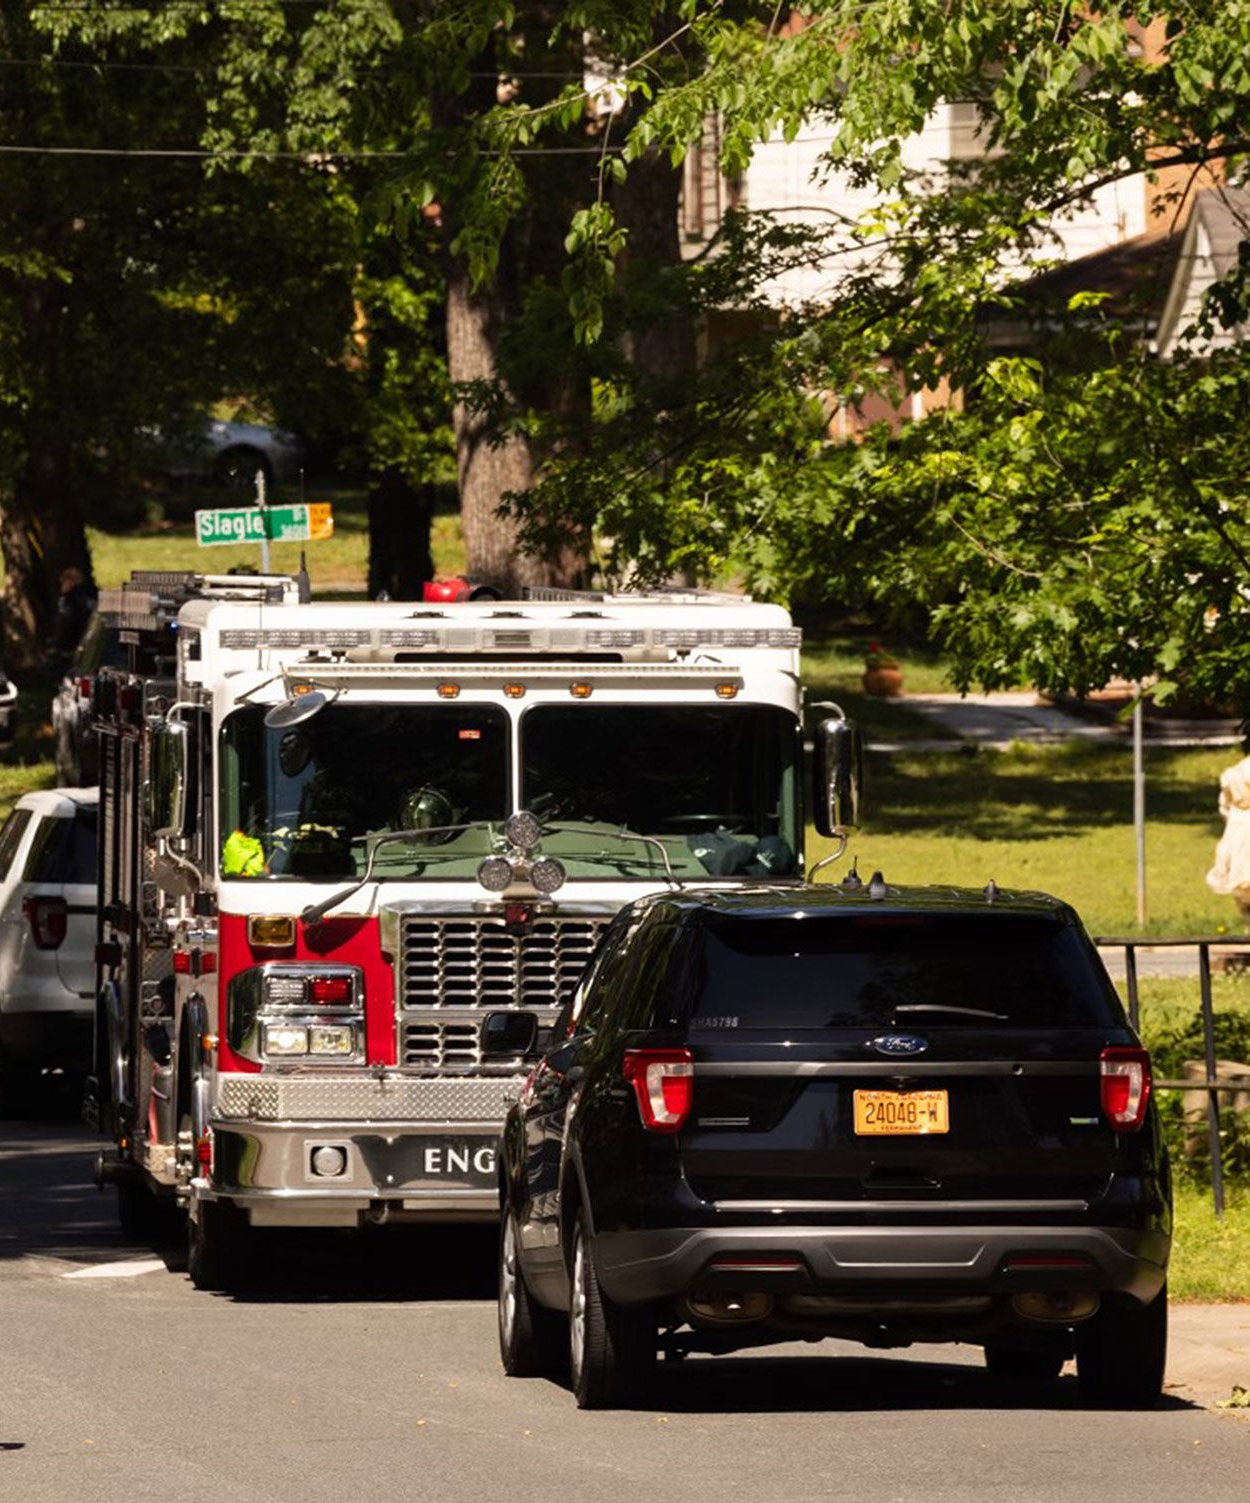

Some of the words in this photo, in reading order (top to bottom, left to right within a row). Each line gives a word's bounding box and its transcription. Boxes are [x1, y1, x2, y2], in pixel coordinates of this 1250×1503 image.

[200, 512, 267, 540] Slagle
[866, 1102, 938, 1124] 24048-W
[424, 1147, 496, 1174] ENG
